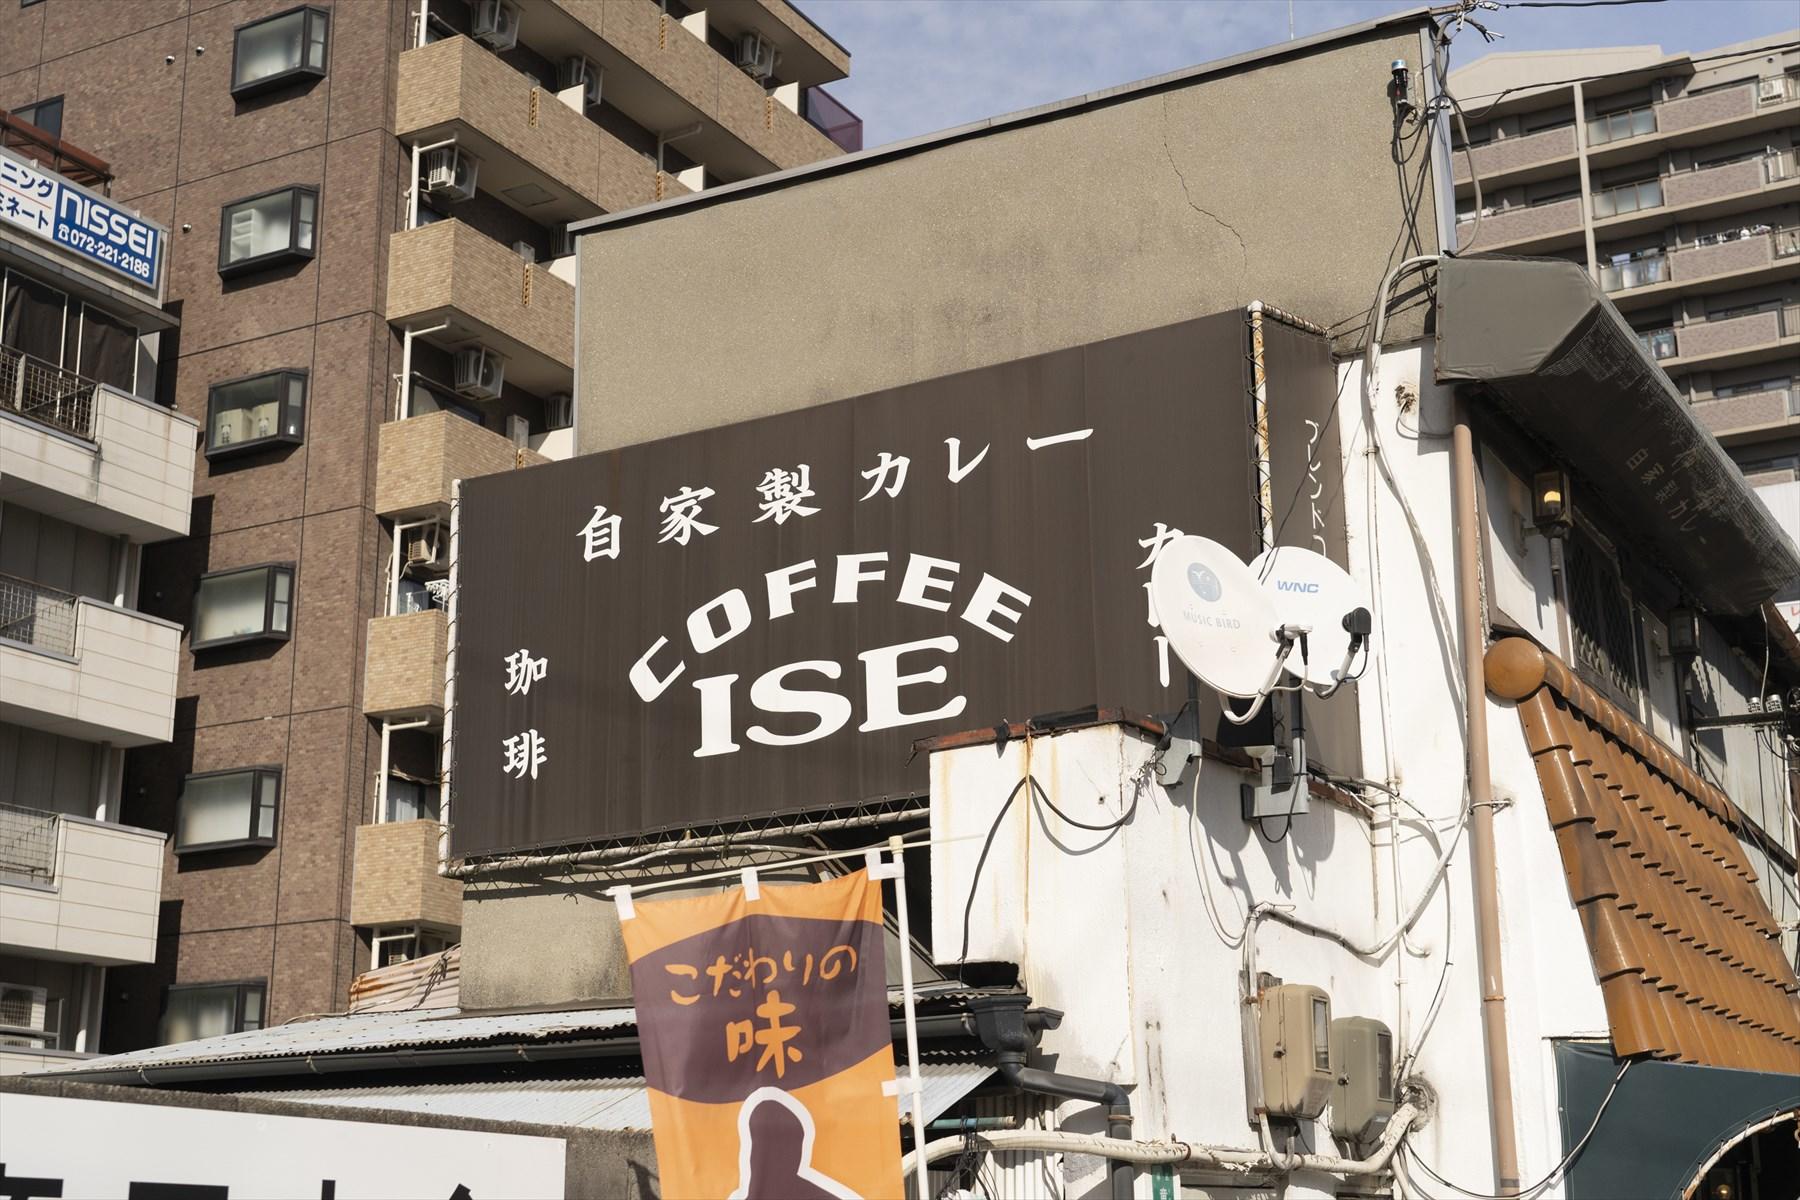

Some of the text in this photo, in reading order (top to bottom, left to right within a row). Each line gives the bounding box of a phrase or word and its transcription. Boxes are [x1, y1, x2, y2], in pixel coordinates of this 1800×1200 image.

[576, 428, 1094, 562] 自家製カレー
[629, 552, 1032, 703] COFFEE
[1215, 617, 1241, 629] BIRD
[1277, 580, 1319, 593] WNC
[502, 648, 548, 780] 珈琲
[693, 635, 967, 758] ISE
[665, 944, 858, 1006] こだわりの
[726, 990, 803, 1079] 味
